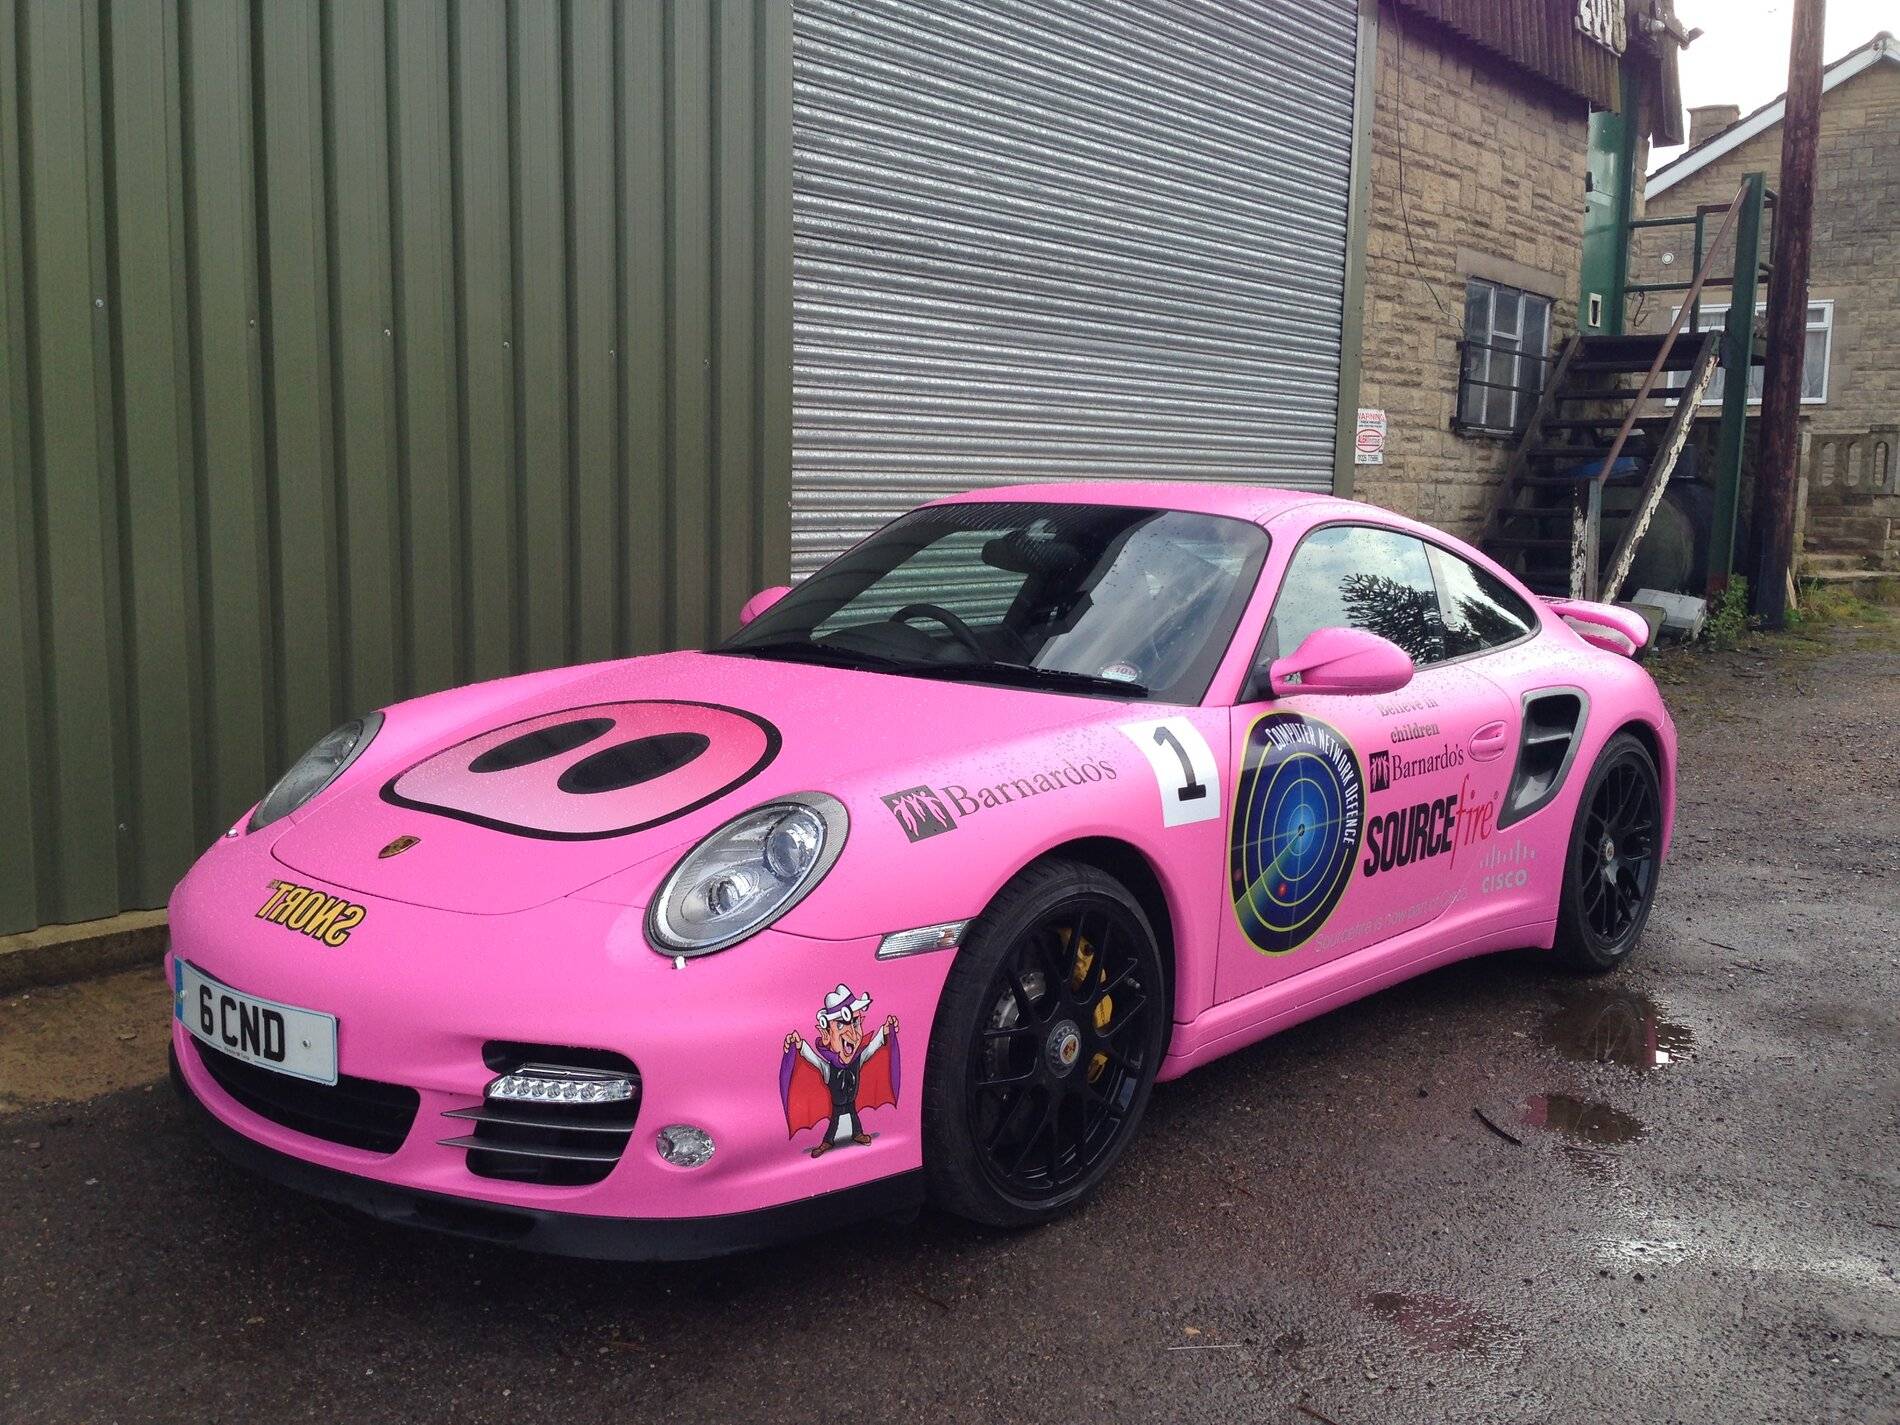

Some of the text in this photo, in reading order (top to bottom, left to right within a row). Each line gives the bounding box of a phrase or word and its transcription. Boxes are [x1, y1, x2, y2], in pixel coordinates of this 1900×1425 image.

[1377, 697, 1440, 717] Believe in
[1390, 722, 1440, 744] children
[938, 756, 1117, 818] Barnardo's
[1153, 726, 1207, 802] 1
[1265, 723, 1358, 845] COMPUTER NETWORK DEFENCE
[1392, 743, 1464, 781] Barnardo's
[200, 984, 286, 1063] 6 CND
